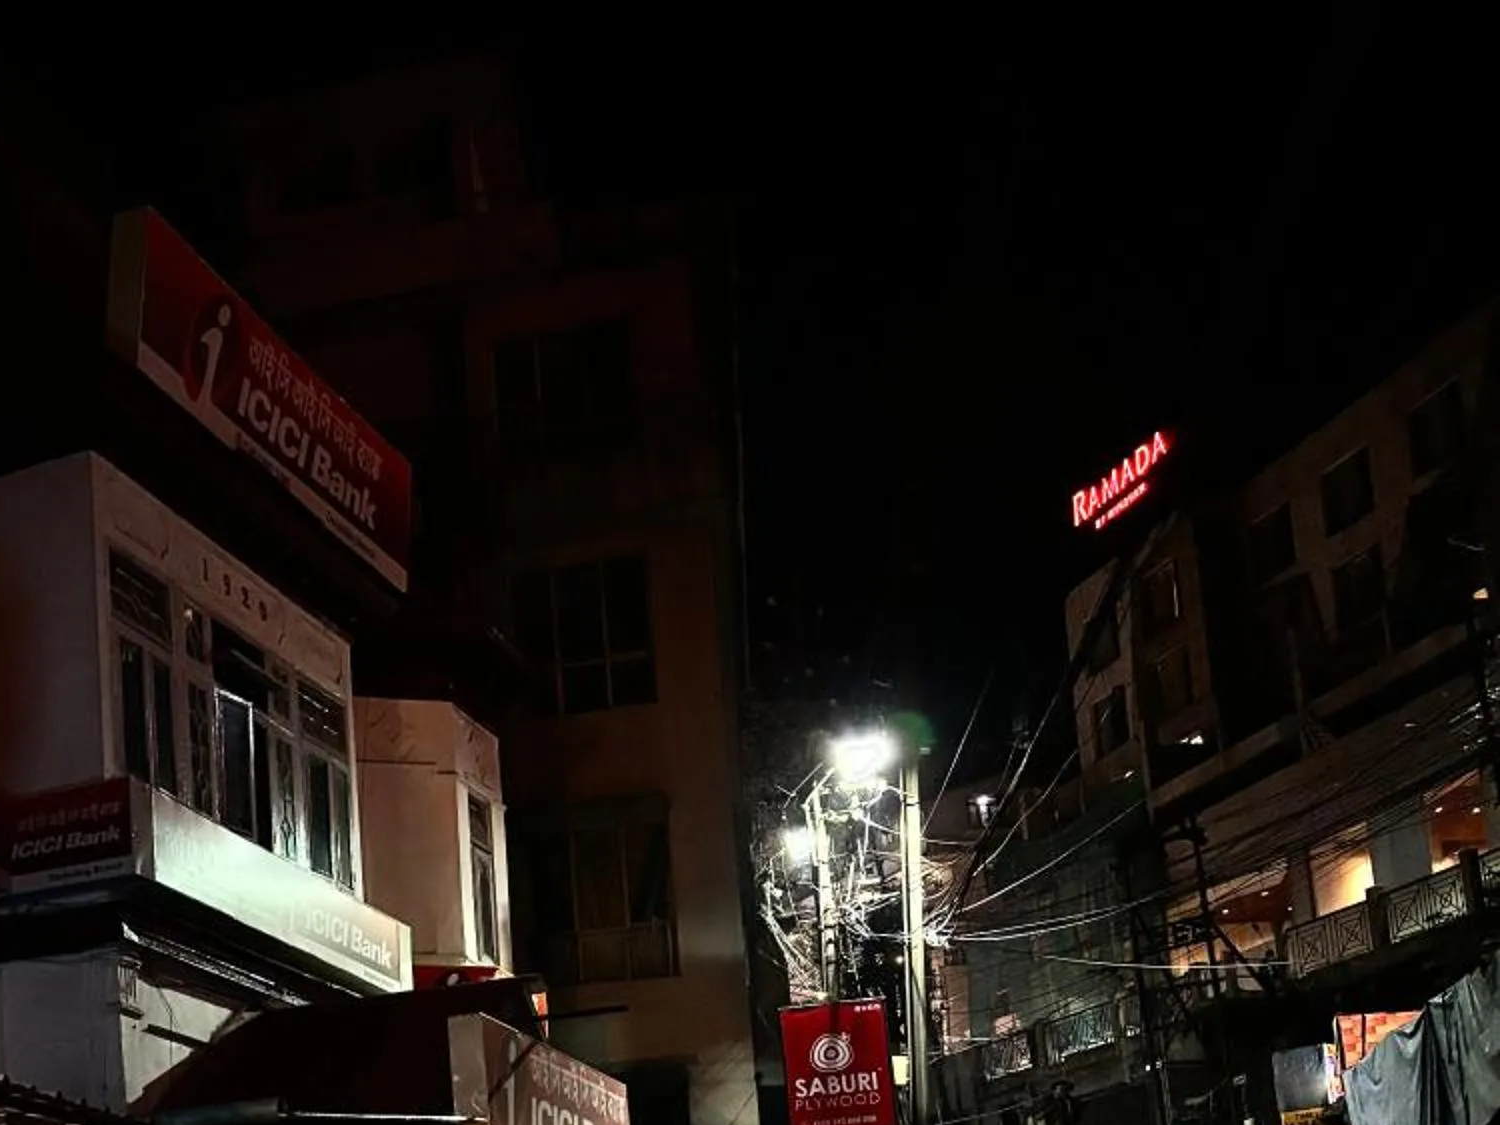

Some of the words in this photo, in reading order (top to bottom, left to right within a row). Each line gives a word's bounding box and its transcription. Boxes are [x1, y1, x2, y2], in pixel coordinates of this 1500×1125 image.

[237, 376, 311, 469] ICICI
[311, 443, 378, 530] Bank
[1072, 431, 1168, 528] RAMADA
[10, 833, 63, 861] ICICI
[65, 824, 121, 850] Bank
[305, 907, 348, 946] ICICI
[351, 924, 393, 970] Bank
[795, 1071, 879, 1098] SABURI
[795, 1091, 881, 1112] PLYWOOD
